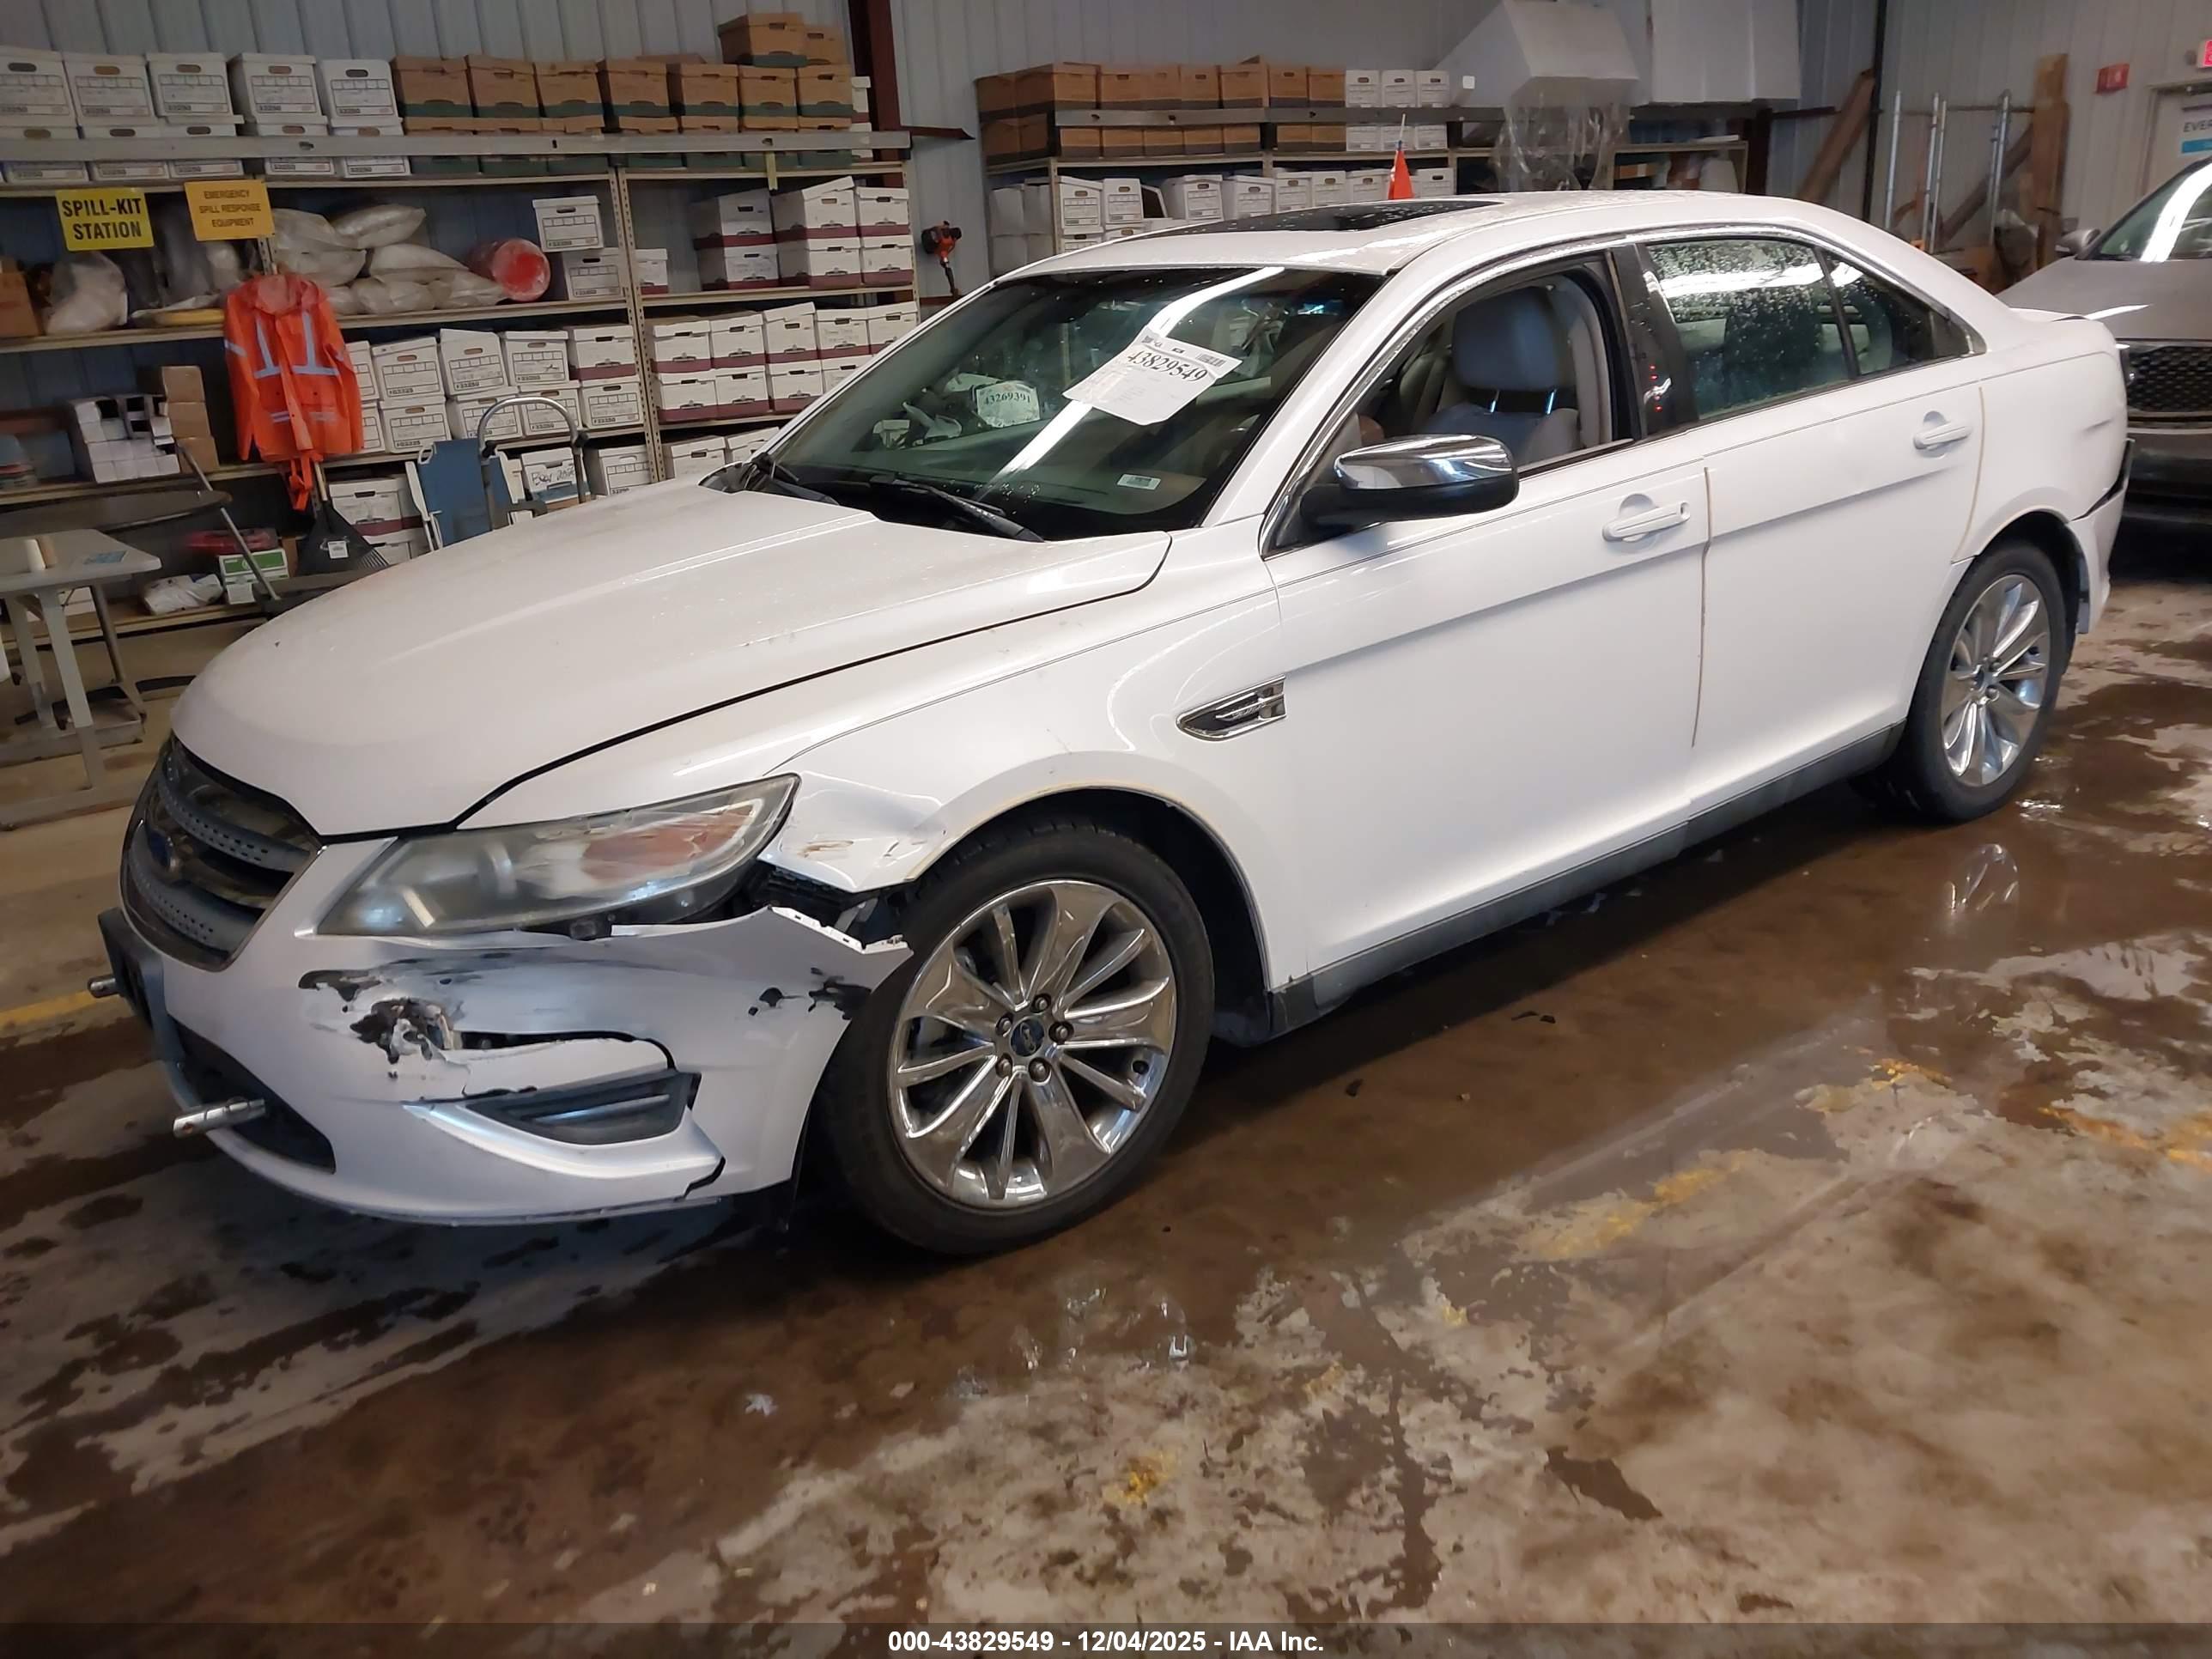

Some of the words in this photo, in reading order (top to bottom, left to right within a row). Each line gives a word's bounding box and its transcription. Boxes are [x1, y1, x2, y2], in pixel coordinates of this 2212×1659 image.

[204, 189, 250, 199] EMERGENCY
[62, 198, 142, 217] SPILL-KIT
[198, 205, 220, 214] SPILL
[221, 203, 262, 212] RESPONSE
[211, 217, 254, 228] EQUIPMENT
[73, 221, 142, 240] STATION
[1127, 350, 1208, 382] 43829549
